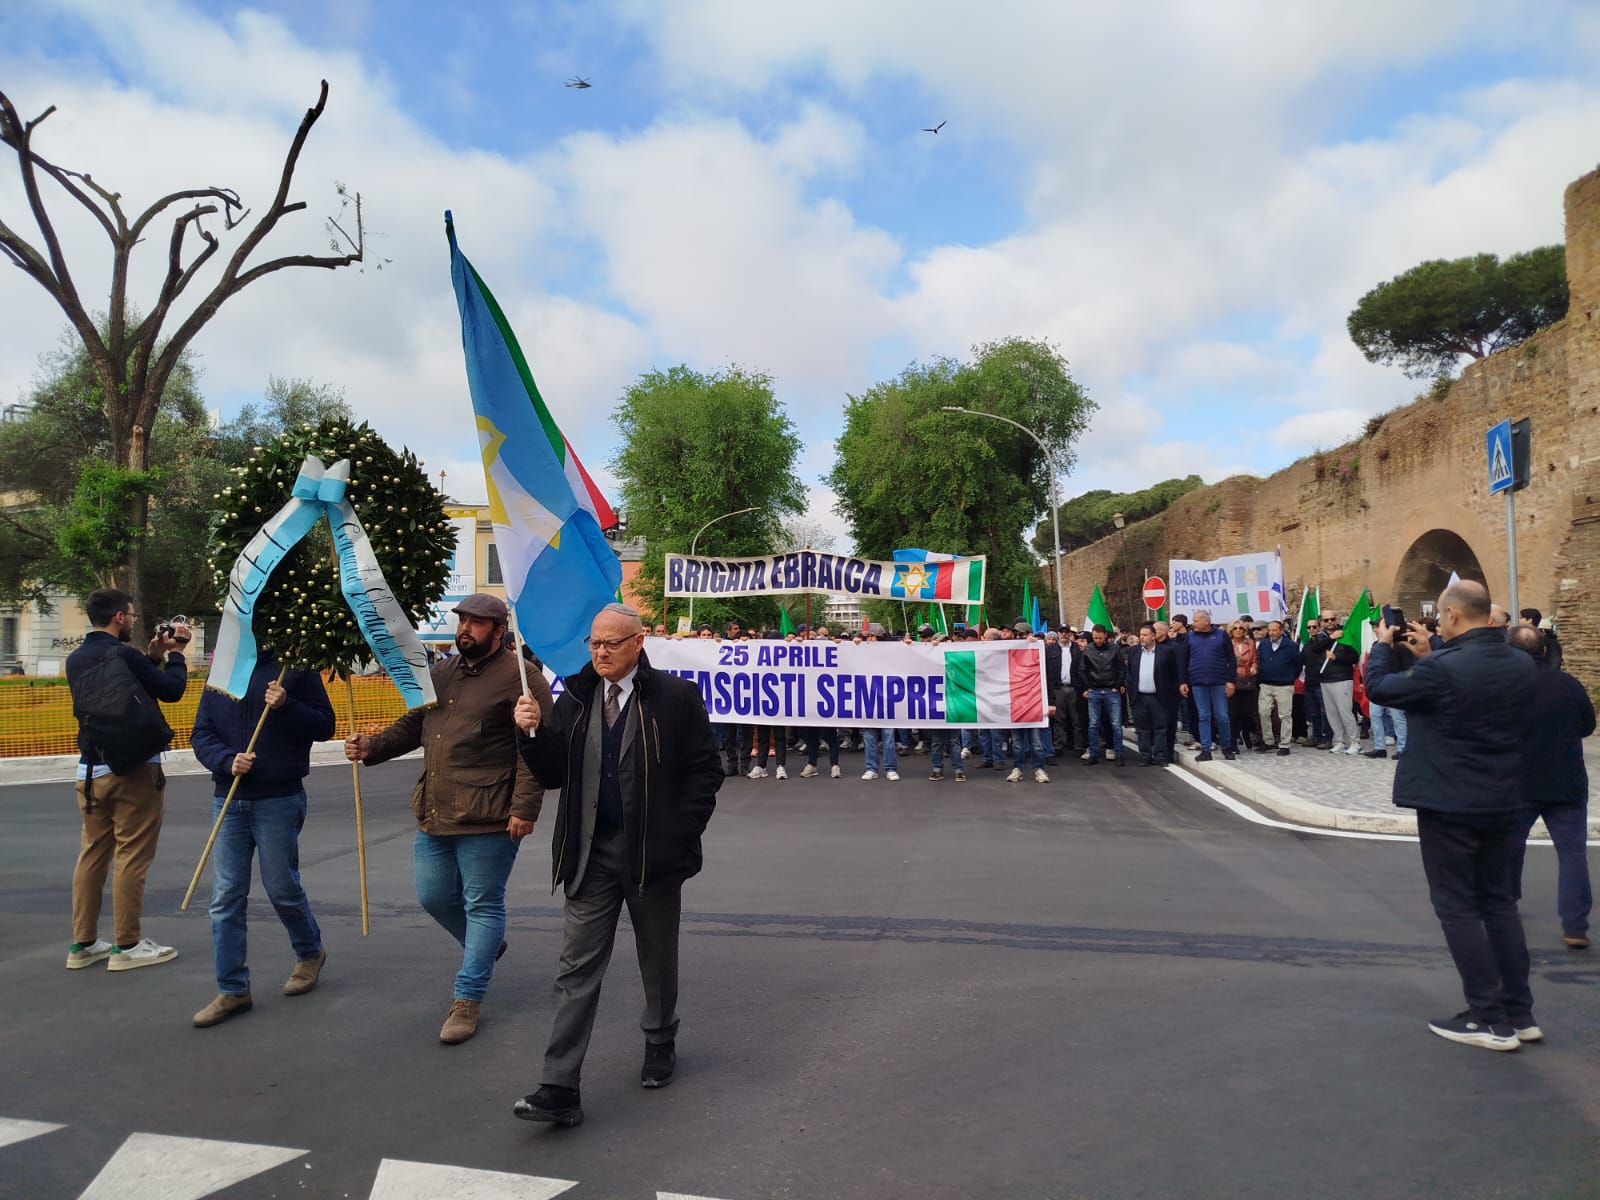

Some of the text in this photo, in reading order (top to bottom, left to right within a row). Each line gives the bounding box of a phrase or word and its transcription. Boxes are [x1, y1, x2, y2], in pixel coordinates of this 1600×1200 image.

[669, 551, 883, 596] BRIGATA EBRAICA
[1175, 568, 1228, 586] BRIGATA
[1175, 589, 1231, 605] EBRAICA
[718, 645, 838, 668] 25 APRILE
[817, 673, 946, 721] SEMPRE
